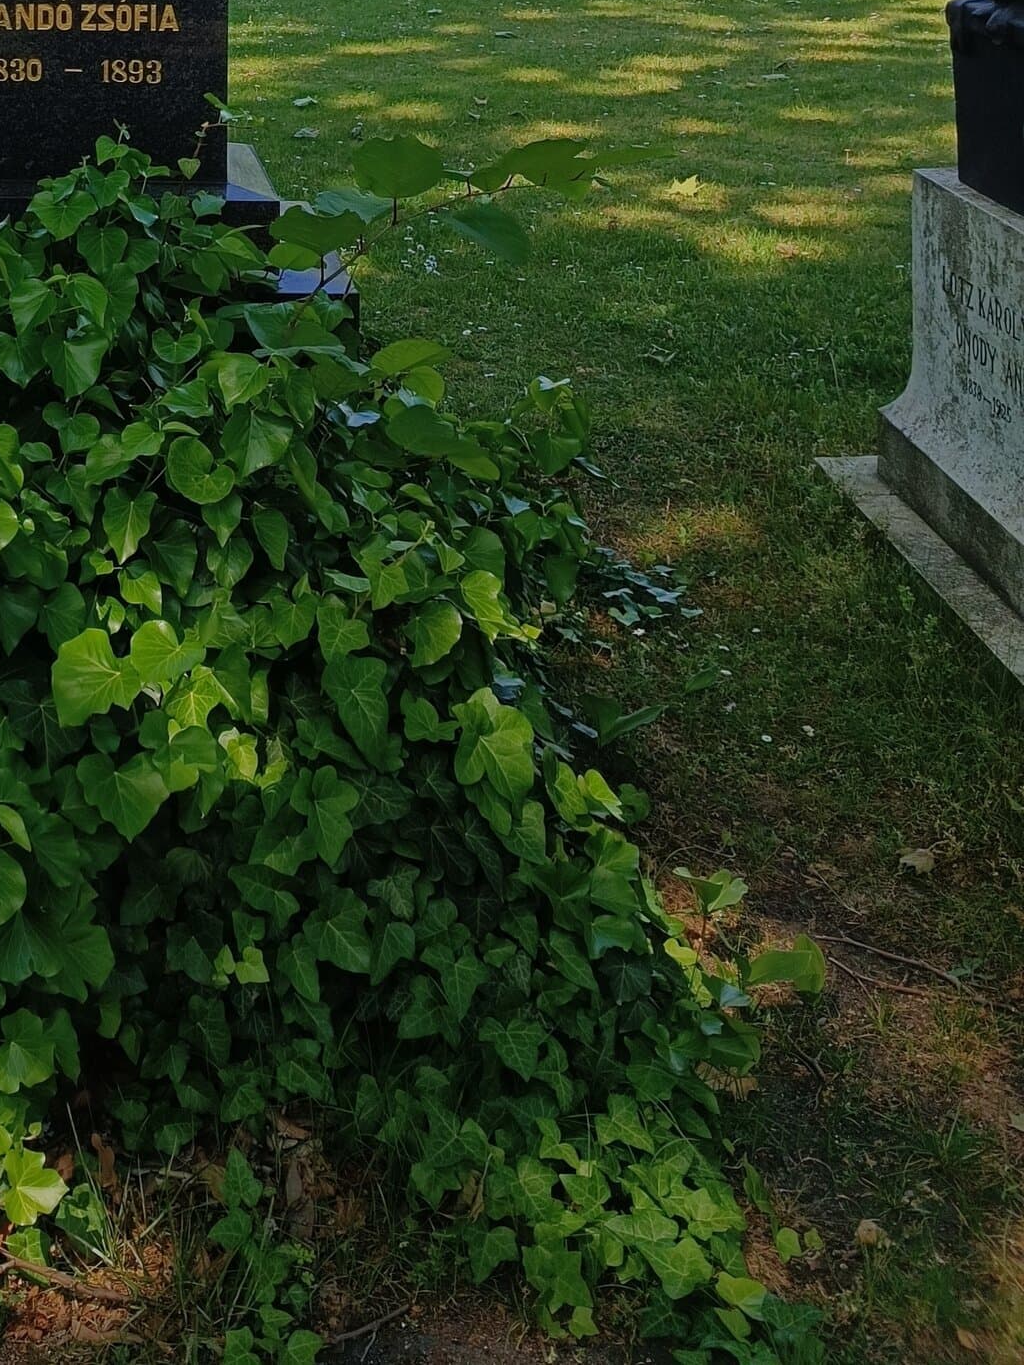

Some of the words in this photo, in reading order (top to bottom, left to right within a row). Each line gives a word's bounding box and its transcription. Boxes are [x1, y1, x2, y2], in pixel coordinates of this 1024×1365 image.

[100, 59, 163, 84] 1893
[942, 265, 974, 311] LOTZ
[978, 286, 1024, 342] KÁROL
